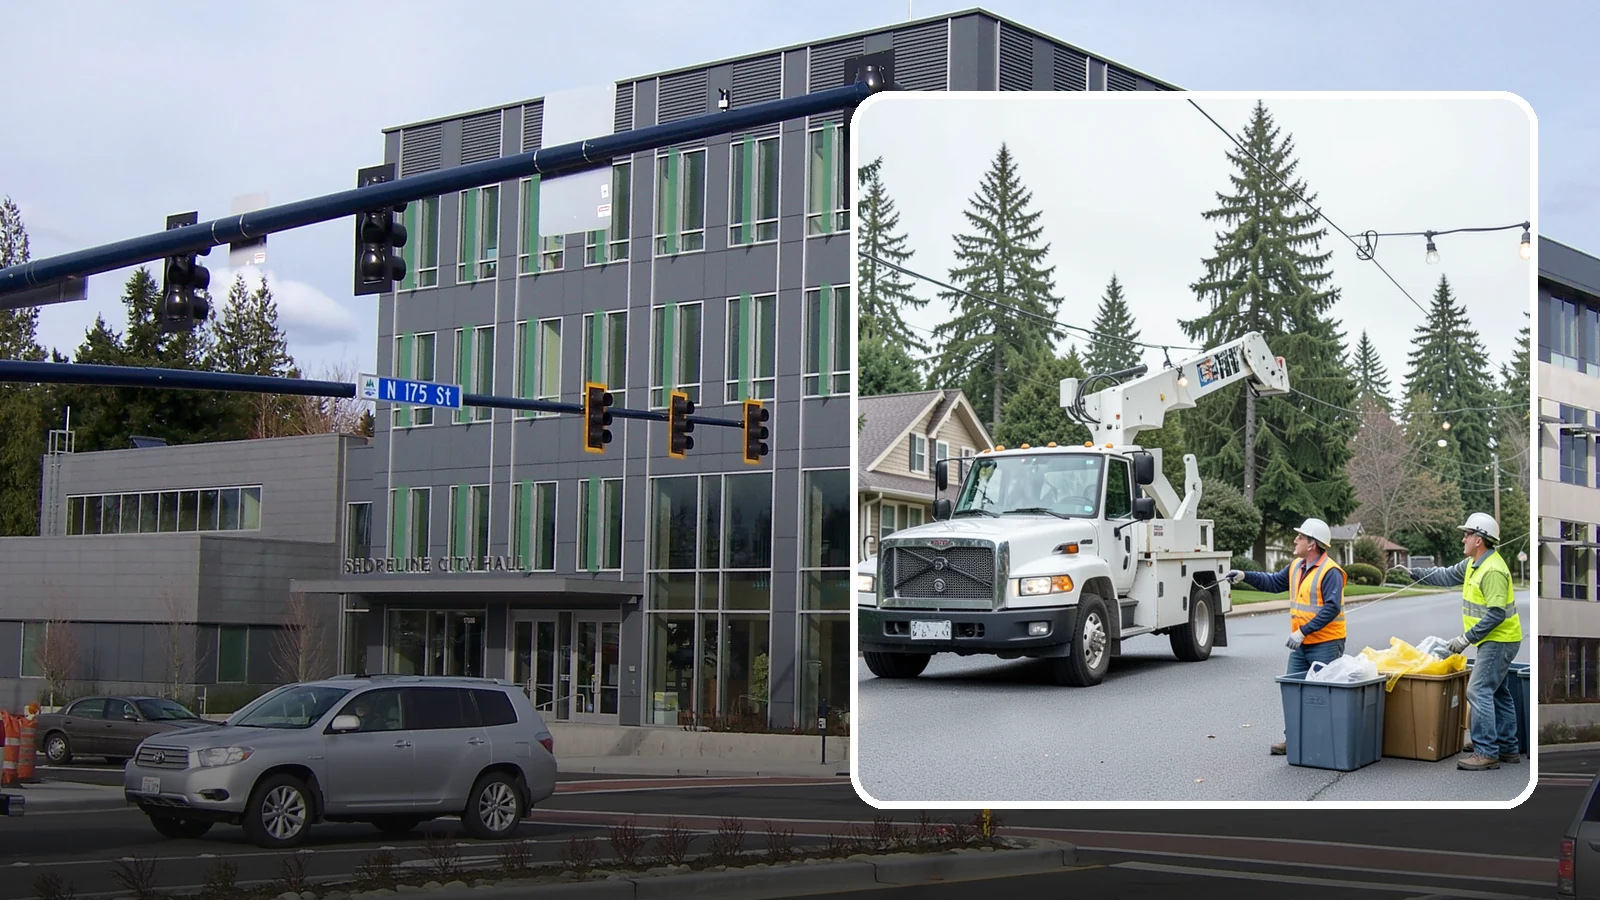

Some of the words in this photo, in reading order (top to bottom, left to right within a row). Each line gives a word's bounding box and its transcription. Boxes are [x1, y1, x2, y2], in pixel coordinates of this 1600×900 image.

[387, 380, 396, 400] N
[405, 382, 428, 403] 175
[436, 386, 451, 406] St
[344, 556, 432, 574] SHORELINE
[438, 556, 476, 573] CITY
[483, 555, 526, 572] HALL
